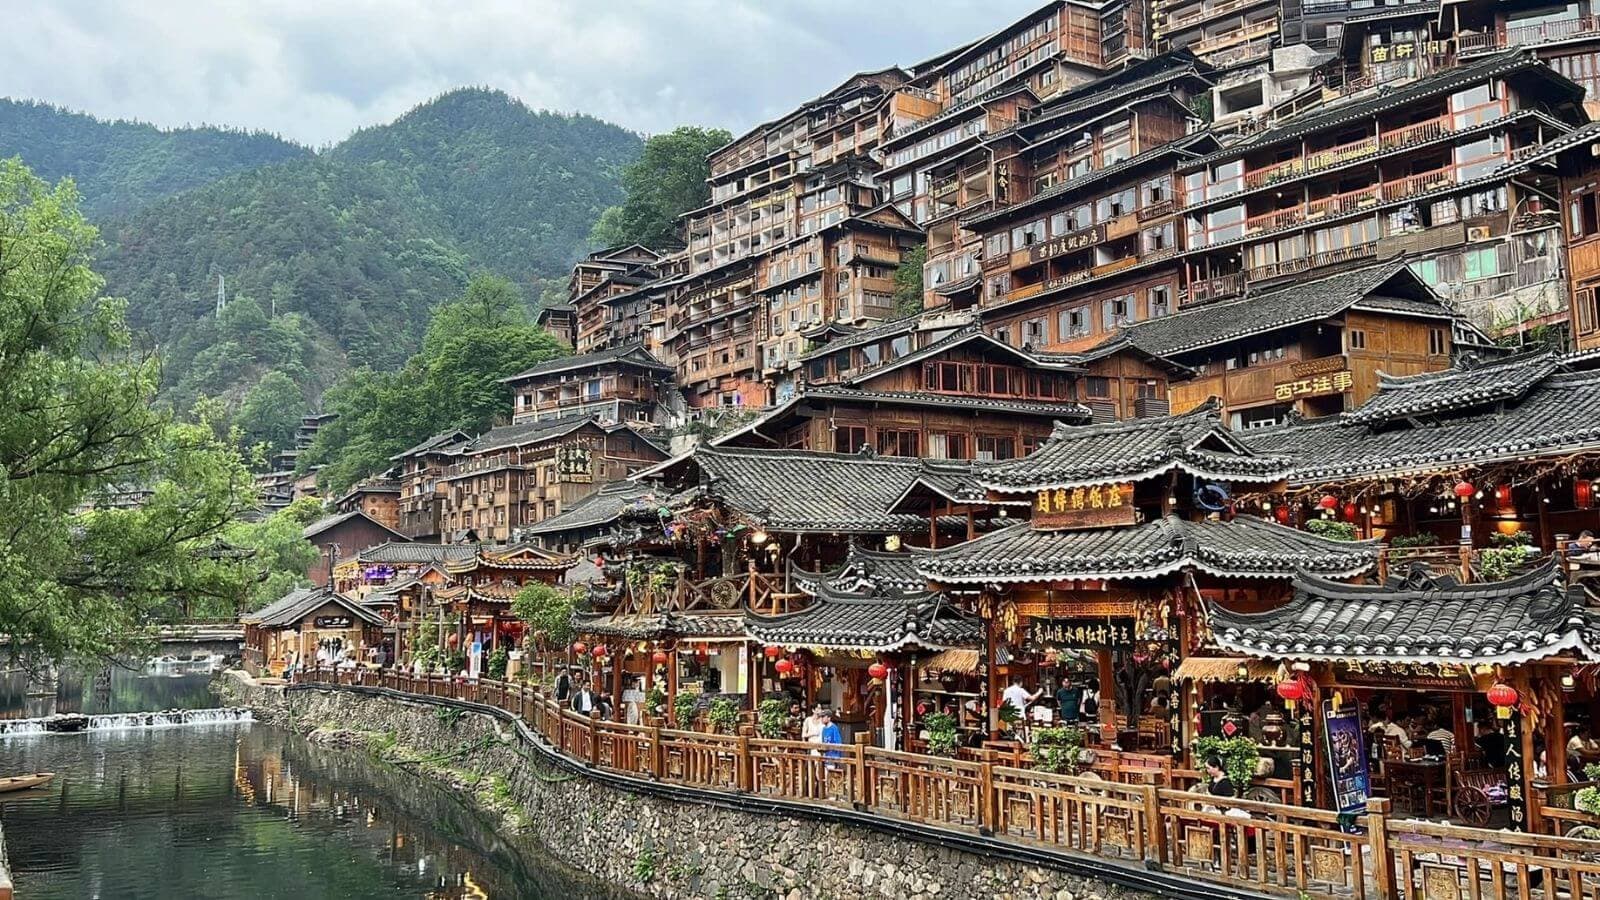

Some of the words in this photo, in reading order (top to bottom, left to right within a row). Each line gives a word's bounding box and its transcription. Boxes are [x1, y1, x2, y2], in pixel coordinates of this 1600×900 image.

[1274, 371, 1353, 400] 西江往事
[1506, 704, 1523, 833] 生人传酸汤
